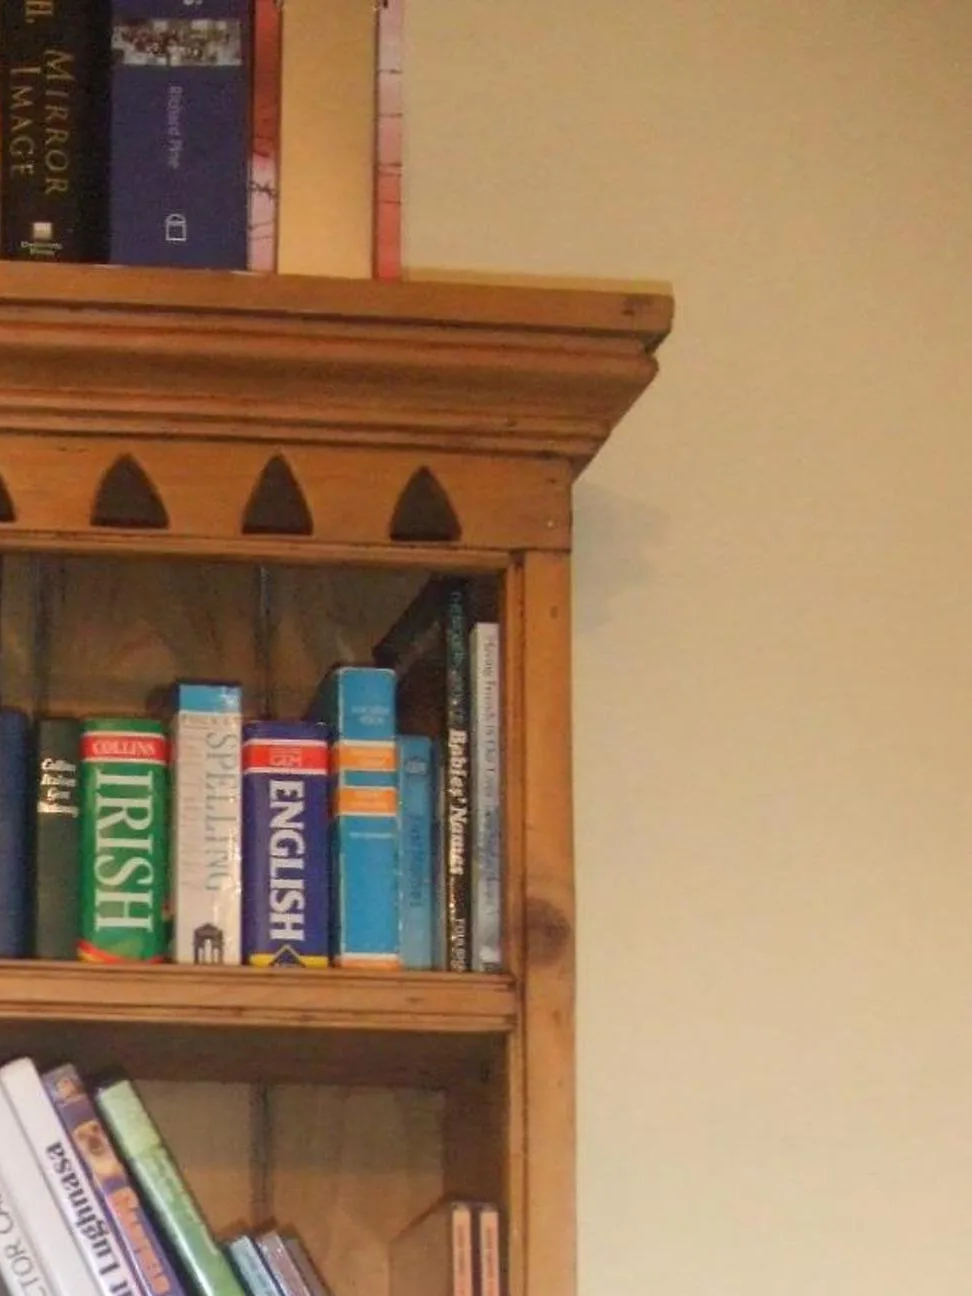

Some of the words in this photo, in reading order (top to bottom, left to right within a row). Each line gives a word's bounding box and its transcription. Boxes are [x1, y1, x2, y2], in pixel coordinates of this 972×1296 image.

[9, 65, 41, 178] IMAGE
[45, 48, 75, 196] MIRROR
[92, 741, 157, 757] COLLINS
[205, 731, 238, 892] SPELLING
[94, 769, 154, 932] IRISH
[268, 779, 307, 942] ENGLISH
[449, 806, 469, 876] Names
[45, 1141, 121, 1280] Lughnasa
